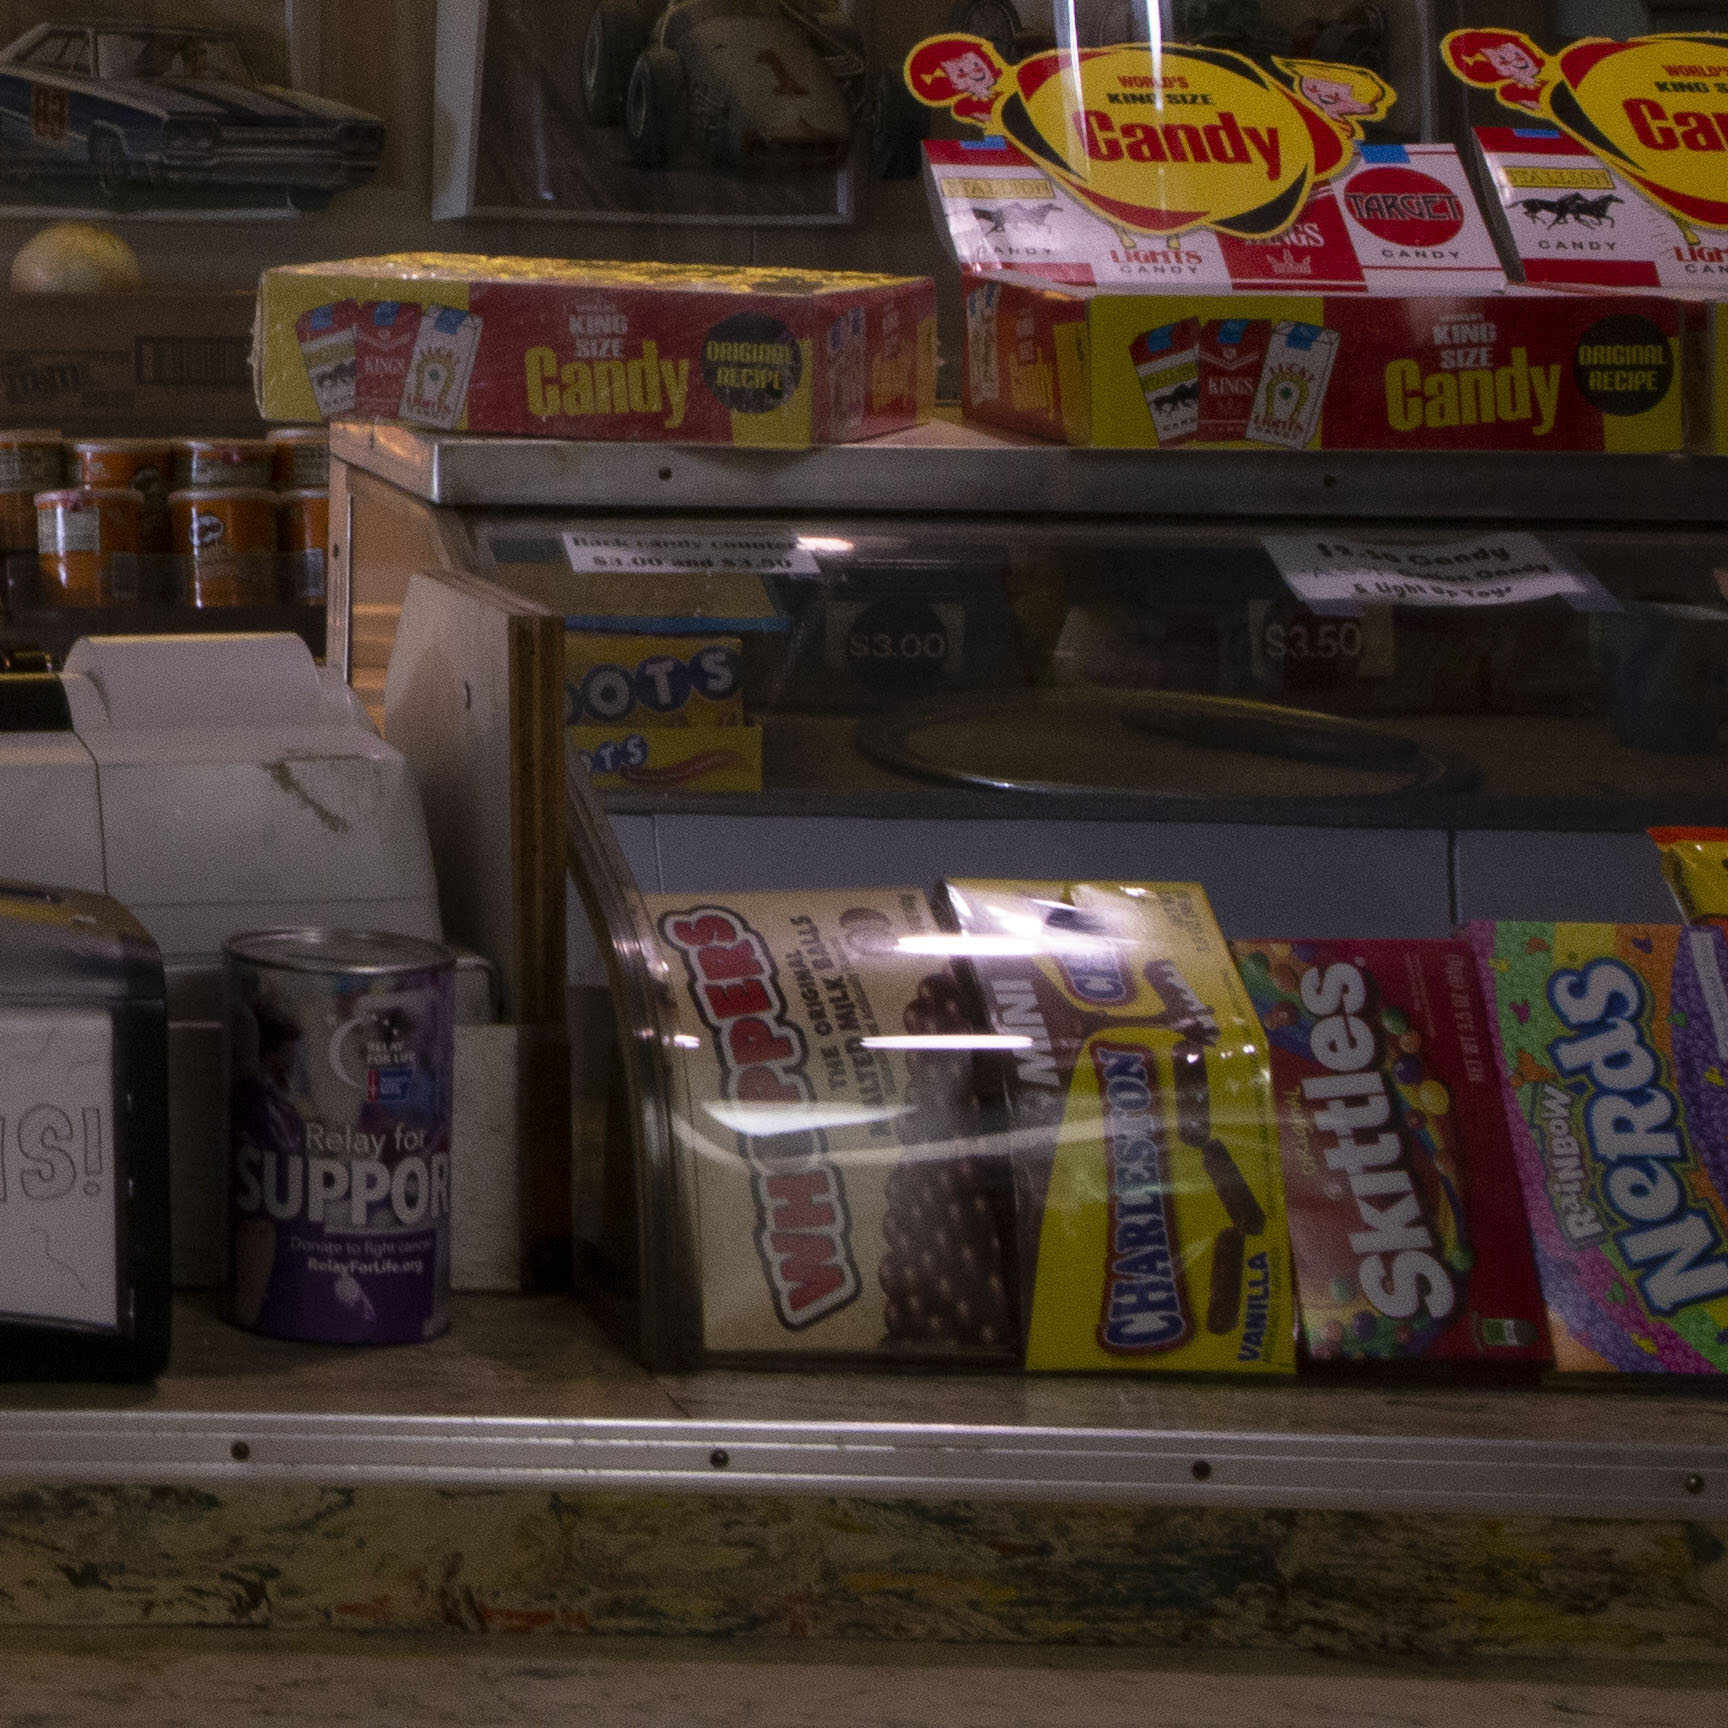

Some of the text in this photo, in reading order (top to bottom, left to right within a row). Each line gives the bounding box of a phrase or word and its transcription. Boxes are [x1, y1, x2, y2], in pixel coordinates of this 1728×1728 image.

[1117, 75, 1190, 90] WORD'S
[1655, 81, 1710, 94] KING
[1168, 93, 1215, 106] SIZE
[1072, 109, 1283, 181] Candy
[1344, 193, 1463, 221] TARGET
[1381, 248, 1460, 261] CANDY
[1537, 238, 1618, 252] CANDY
[568, 314, 629, 335] KING
[1432, 323, 1497, 347] KING
[574, 337, 626, 359] SIZE
[705, 339, 793, 365] ORIGINAL
[1440, 347, 1494, 371] SIZE
[1577, 344, 1668, 367] ORIGINAL
[523, 338, 690, 430] Candy
[715, 366, 784, 391] RECIPE
[1207, 375, 1254, 396] KINGS
[1384, 345, 1563, 437] Candy
[1588, 369, 1659, 392] RECIPE
[848, 631, 946, 660] $3.00
[1264, 622, 1363, 660] $3.50
[564, 651, 734, 719] OTS
[791, 914, 832, 971] BALLS
[786, 950, 834, 1037] ORIGINAL
[824, 975, 859, 1032] MILK
[990, 977, 1061, 1087] MINI
[819, 1046, 848, 1092] THE
[304, 1122, 428, 1161] Relay for
[1300, 961, 1455, 1320] Skittles
[1102, 1049, 1186, 1346] CHARLESTON
[1238, 1250, 1270, 1364] VANILLA
